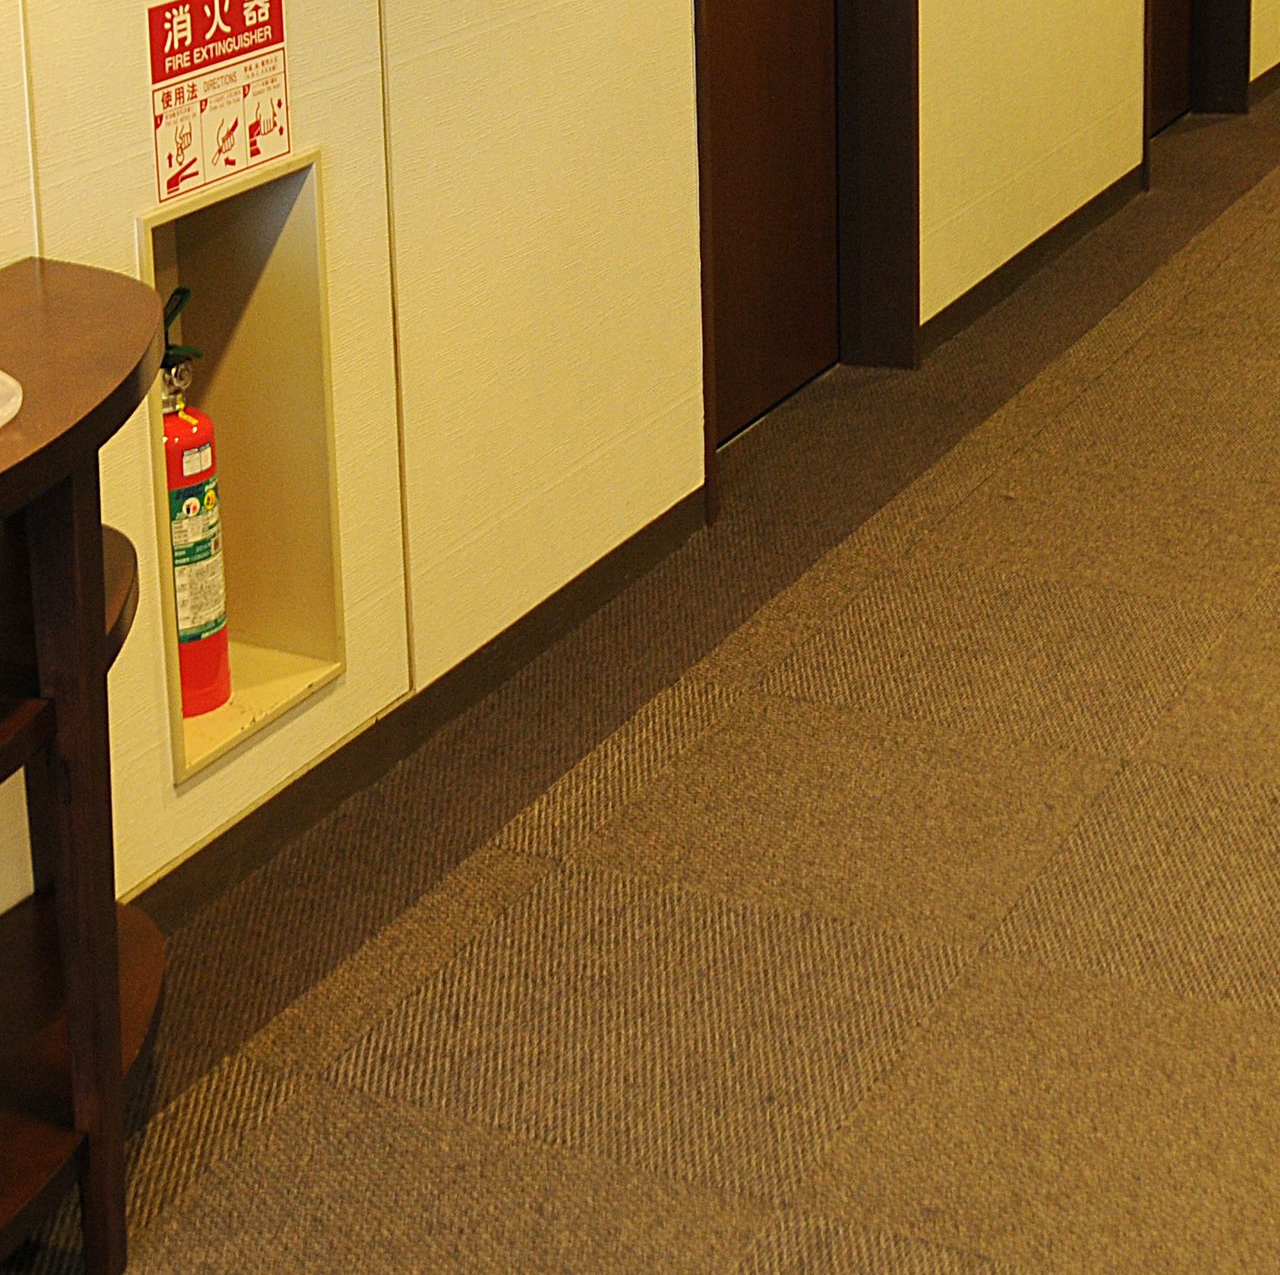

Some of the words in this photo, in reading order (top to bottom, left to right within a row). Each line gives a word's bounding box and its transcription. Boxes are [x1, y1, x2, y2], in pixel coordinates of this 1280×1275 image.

[165, 51, 191, 73] FIRE
[193, 25, 272, 64] EXTINGUISHER
[203, 70, 238, 93] DIRECTIONS
[161, 82, 198, 110] 使用法
